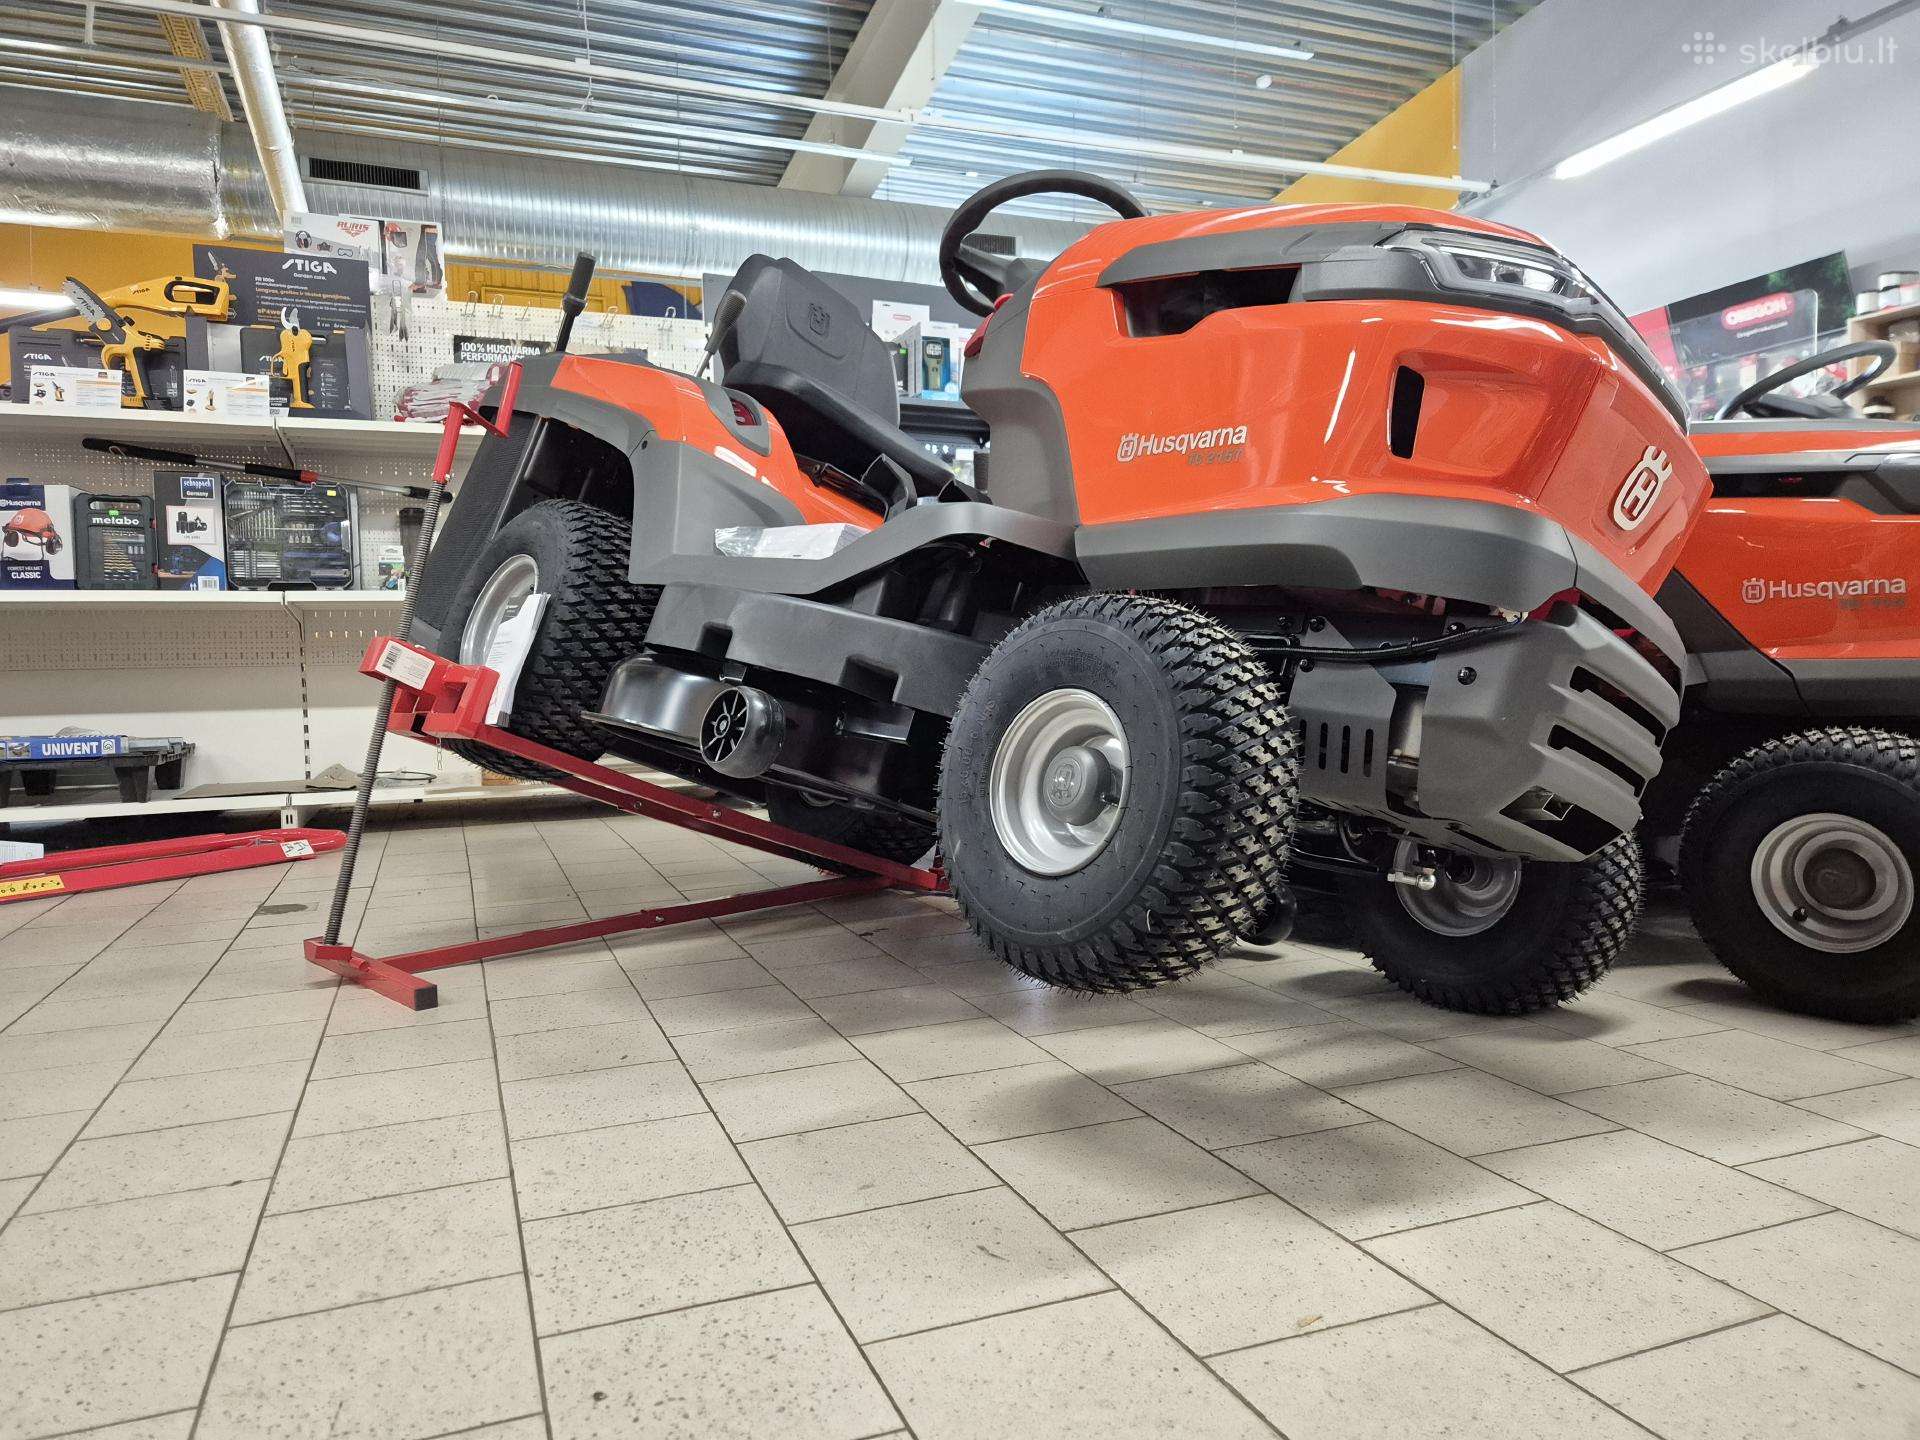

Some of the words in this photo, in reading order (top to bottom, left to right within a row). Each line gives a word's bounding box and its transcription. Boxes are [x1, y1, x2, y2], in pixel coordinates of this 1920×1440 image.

[281, 258, 338, 275] STIGA
[293, 272, 313, 280] Garden
[132, 286, 150, 295] STIGA
[77, 296, 96, 317] STIGA
[460, 341, 485, 353] 100%
[486, 343, 541, 356] HUSQVARNA
[23, 352, 53, 361] STIGA
[33, 370, 56, 378] STIGA
[188, 376, 207, 384] STIGA
[1137, 425, 1248, 456] Husqvarna
[186, 490, 209, 498] Germany
[5, 499, 41, 508] Husqvarna
[92, 515, 140, 526] metabo
[11, 571, 42, 580] CLASSIC
[1769, 577, 1907, 600] Husqvarna
[42, 741, 99, 756] UNIVENT
